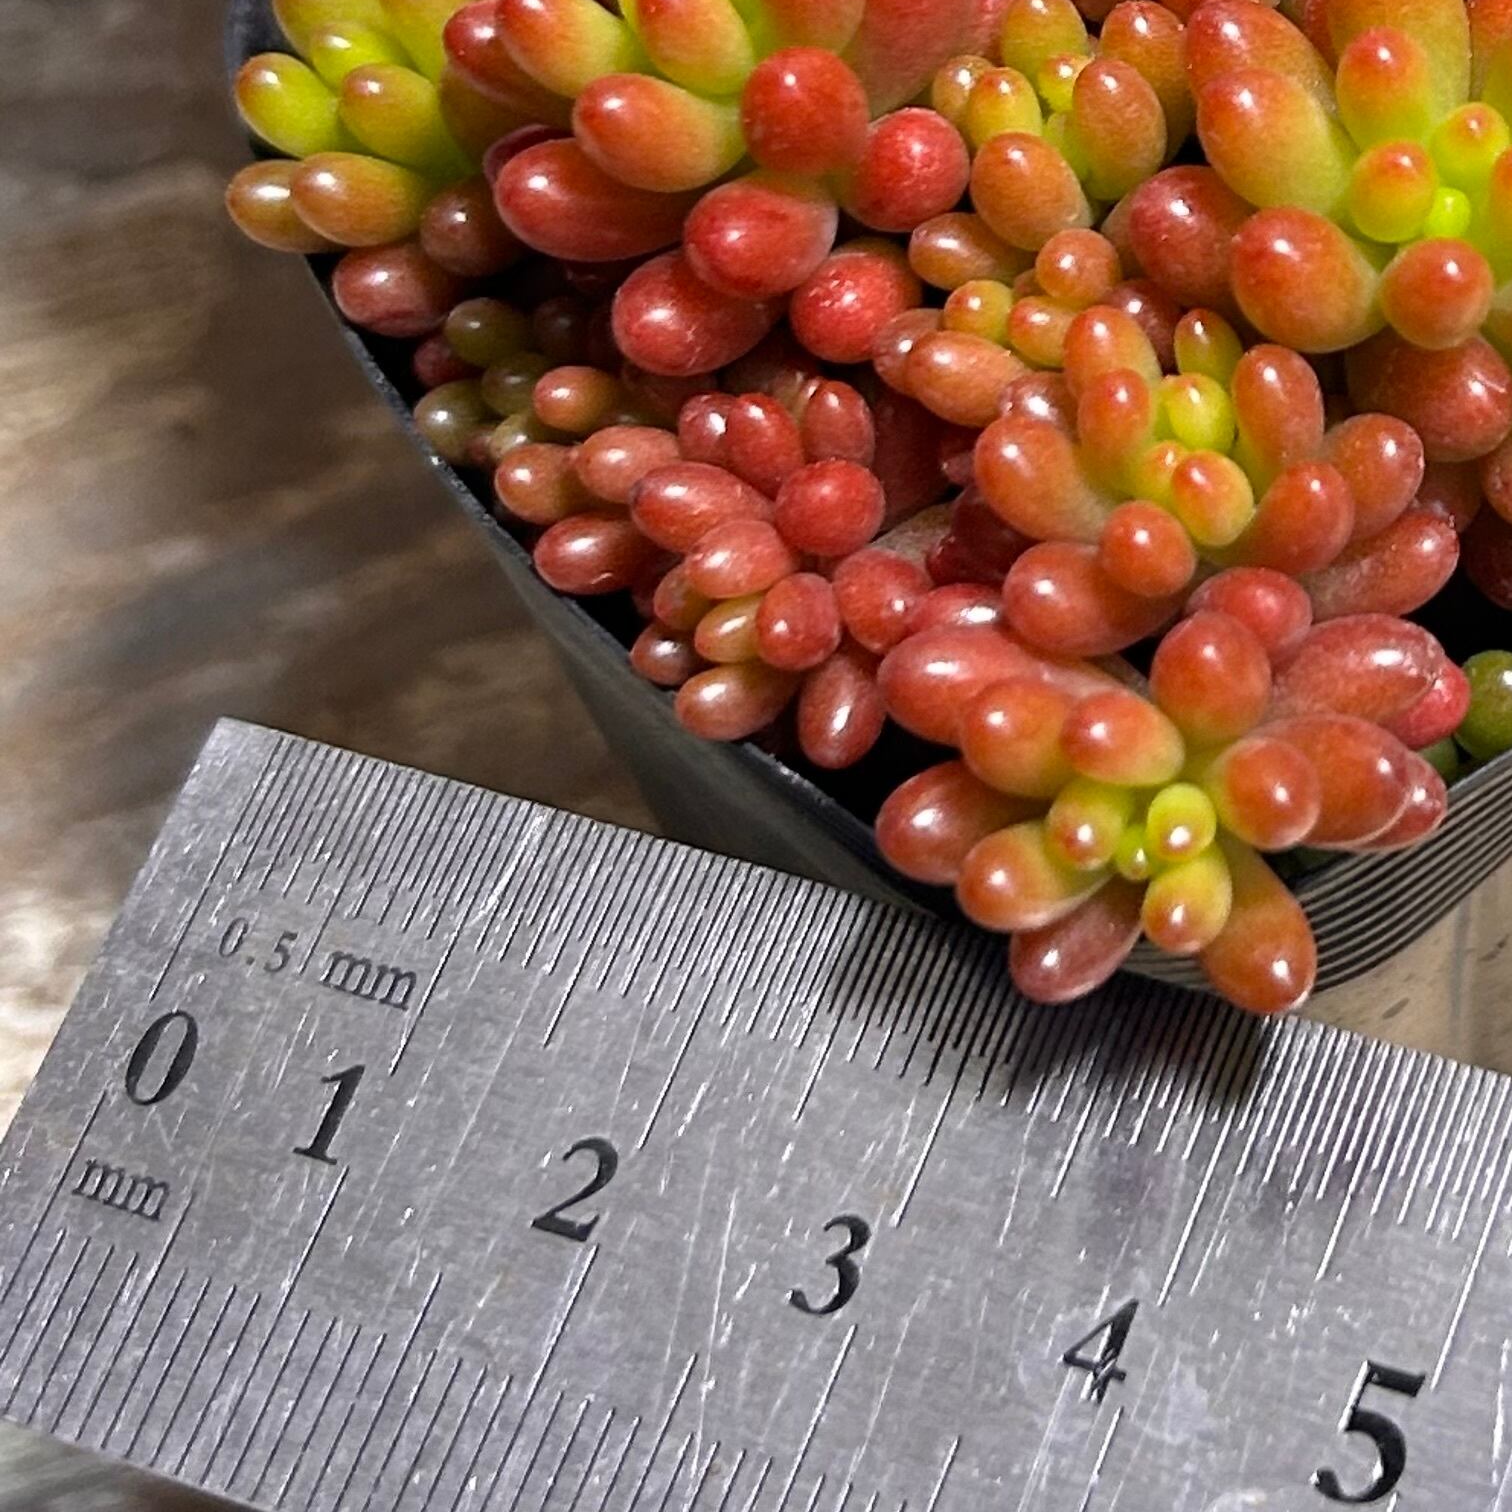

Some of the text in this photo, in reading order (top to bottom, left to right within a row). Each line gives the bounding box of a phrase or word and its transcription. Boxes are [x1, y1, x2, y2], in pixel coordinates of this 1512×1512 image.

[219, 918, 419, 1010] 0.5 mm
[73, 1159, 171, 1221] mm
[124, 1010, 1425, 1504] 0 1 2 3 4 5
